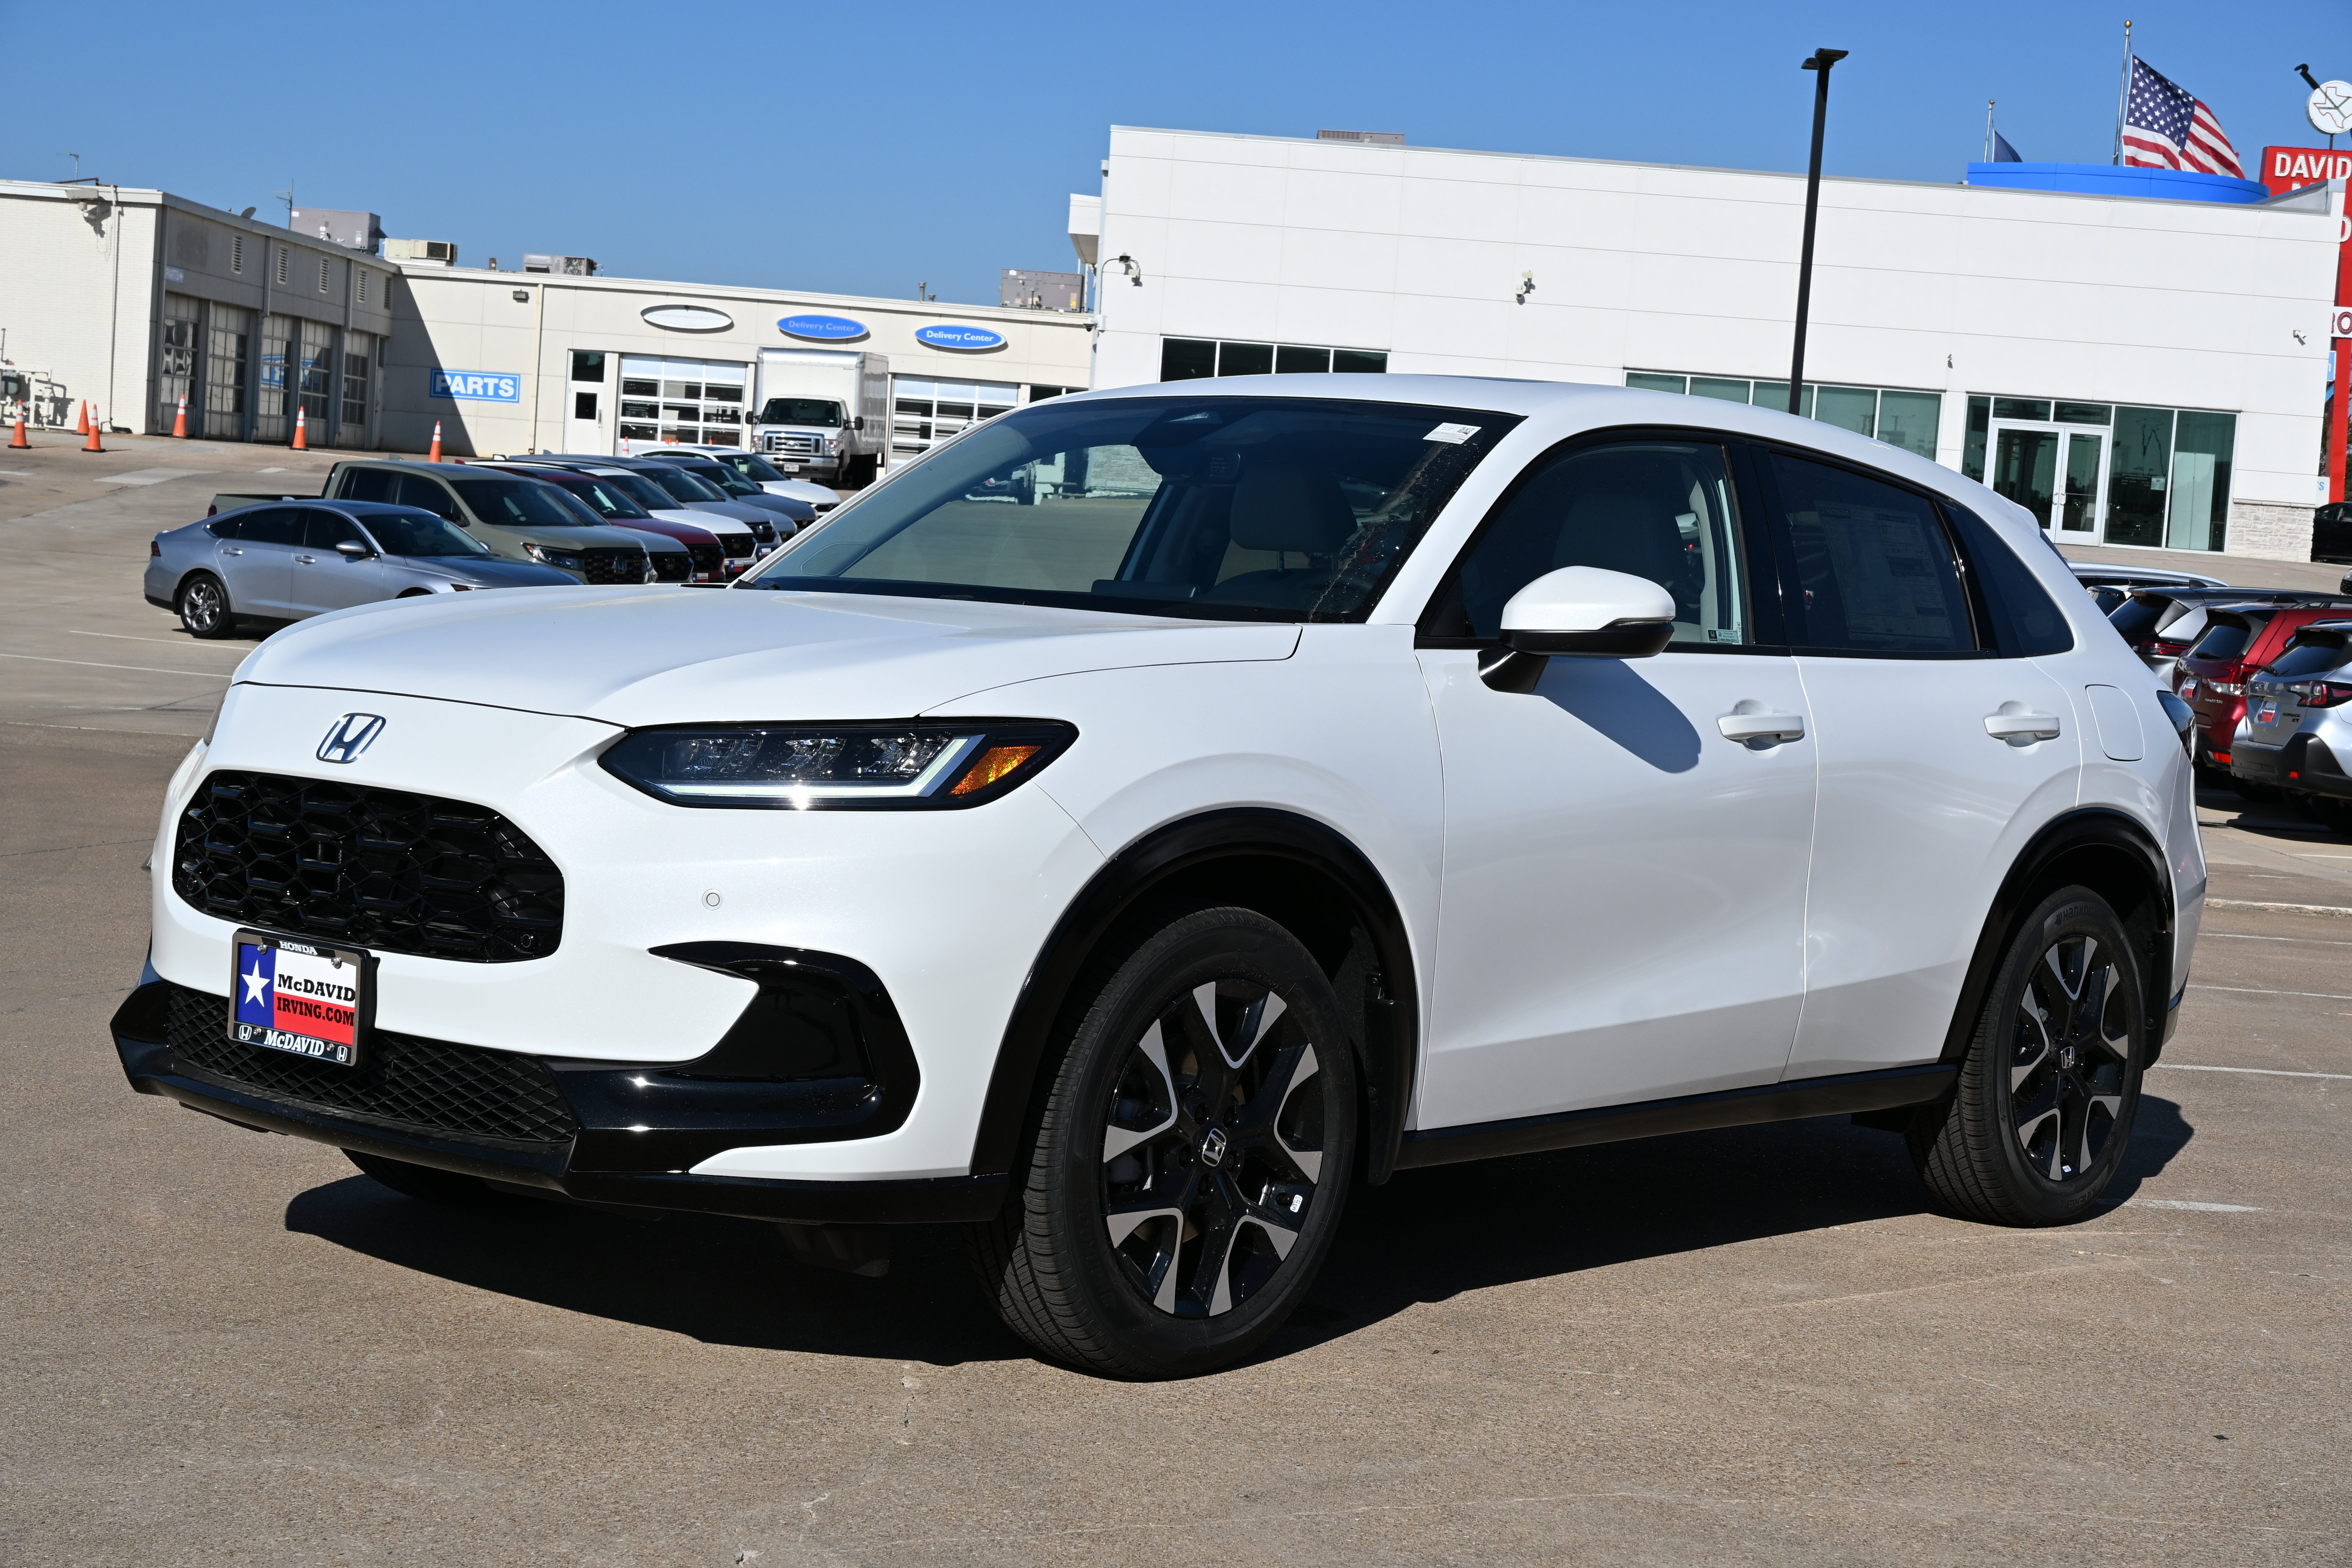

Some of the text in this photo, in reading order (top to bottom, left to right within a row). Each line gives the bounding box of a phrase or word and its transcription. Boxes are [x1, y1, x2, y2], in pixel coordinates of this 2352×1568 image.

[2275, 152, 2352, 180] DAVID
[166, 268, 180, 281] PARTS
[788, 321, 856, 332] Delivery Center
[926, 330, 994, 341] Delivery Center
[436, 374, 514, 397] PARTS
[1826, 507, 1851, 516] HONDA
[279, 941, 318, 956] HONDA
[278, 974, 356, 1002] McDAVID
[277, 996, 354, 1026] IRVING.COM
[264, 1029, 324, 1056] McDAVID
